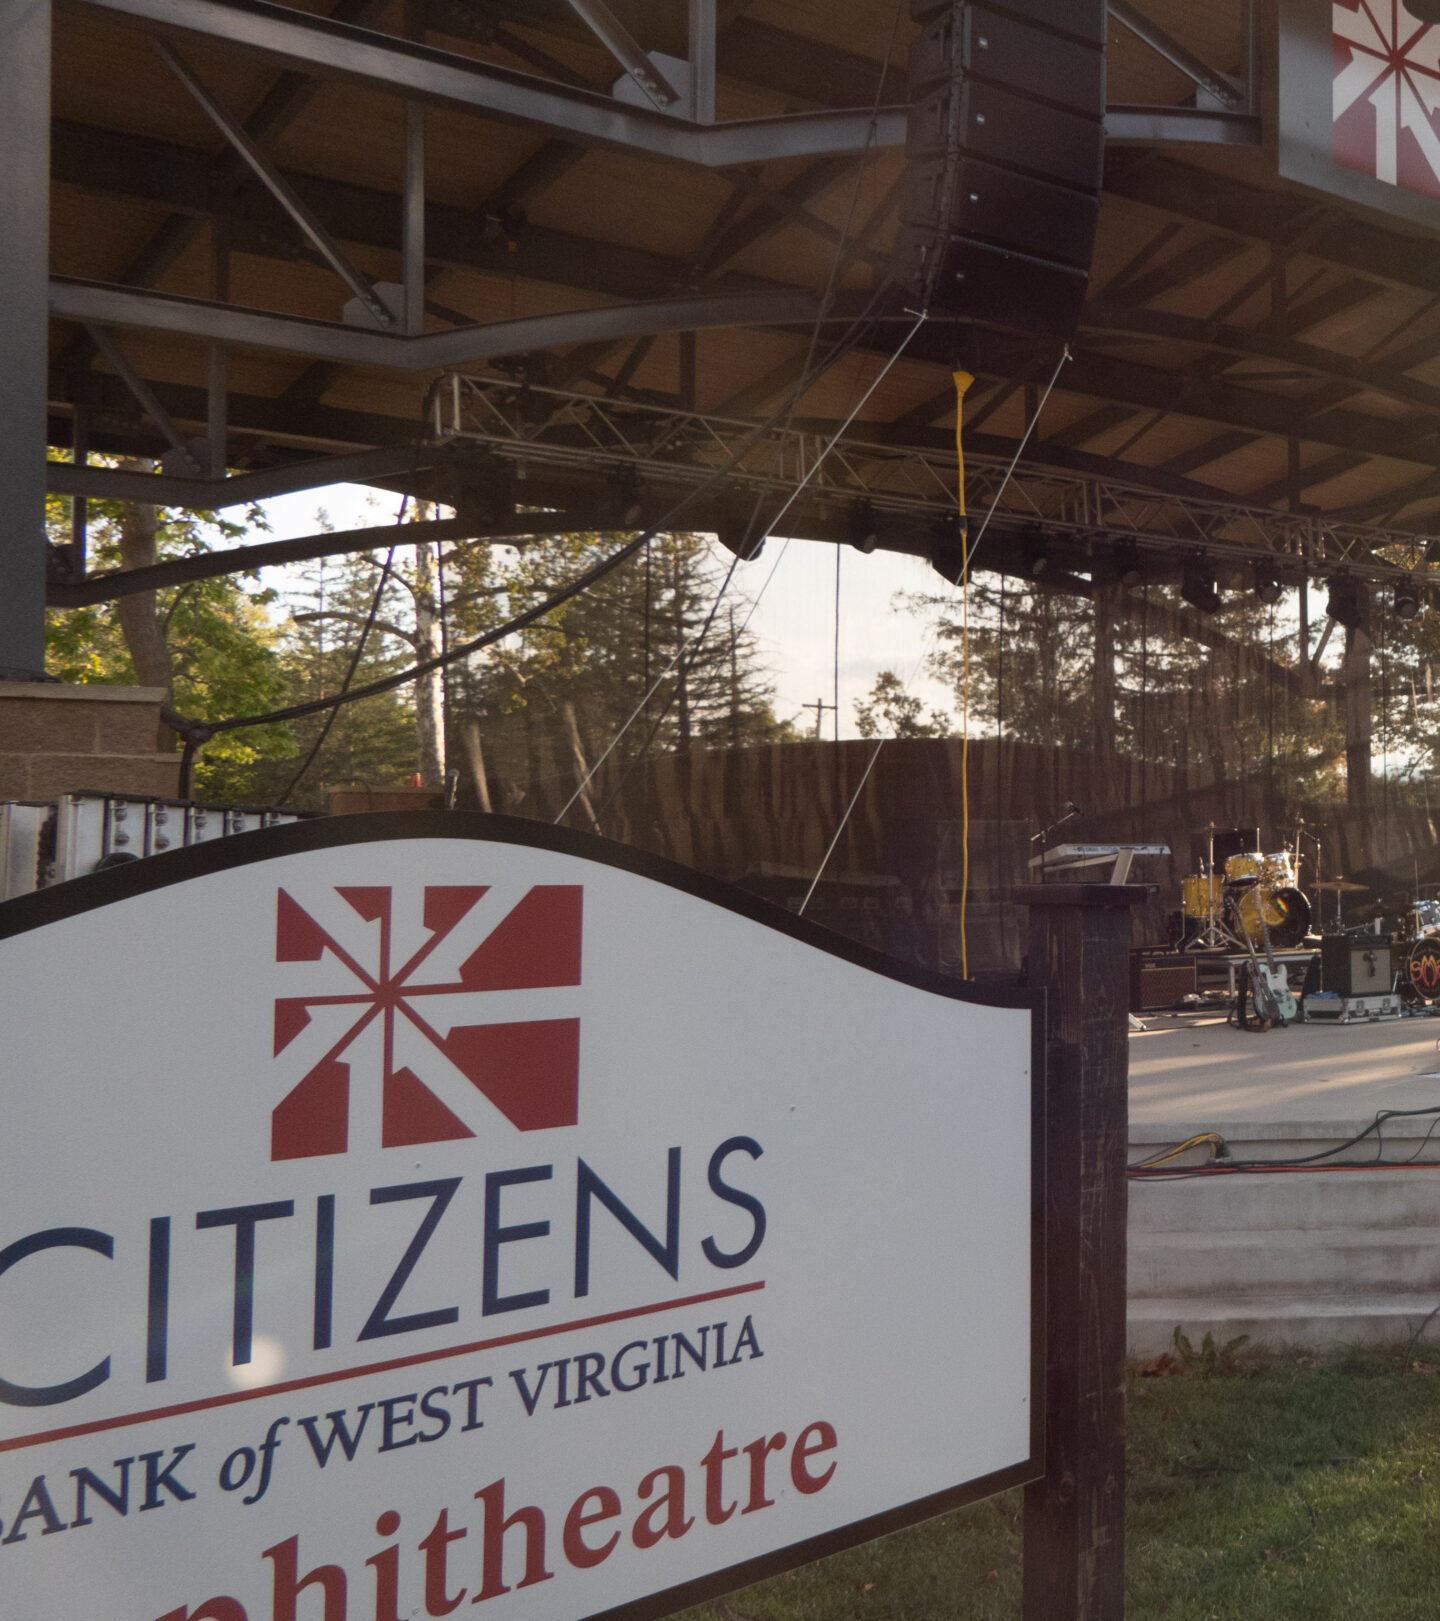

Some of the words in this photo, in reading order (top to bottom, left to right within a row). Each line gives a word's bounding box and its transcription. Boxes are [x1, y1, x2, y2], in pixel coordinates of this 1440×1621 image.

[0, 1135, 767, 1407] CITIZENS
[0, 1443, 197, 1546] ANK
[219, 1416, 290, 1505] of
[298, 1377, 492, 1469] WEST
[509, 1315, 764, 1417] VIRGINIA
[153, 1420, 839, 1621] hitheatre
